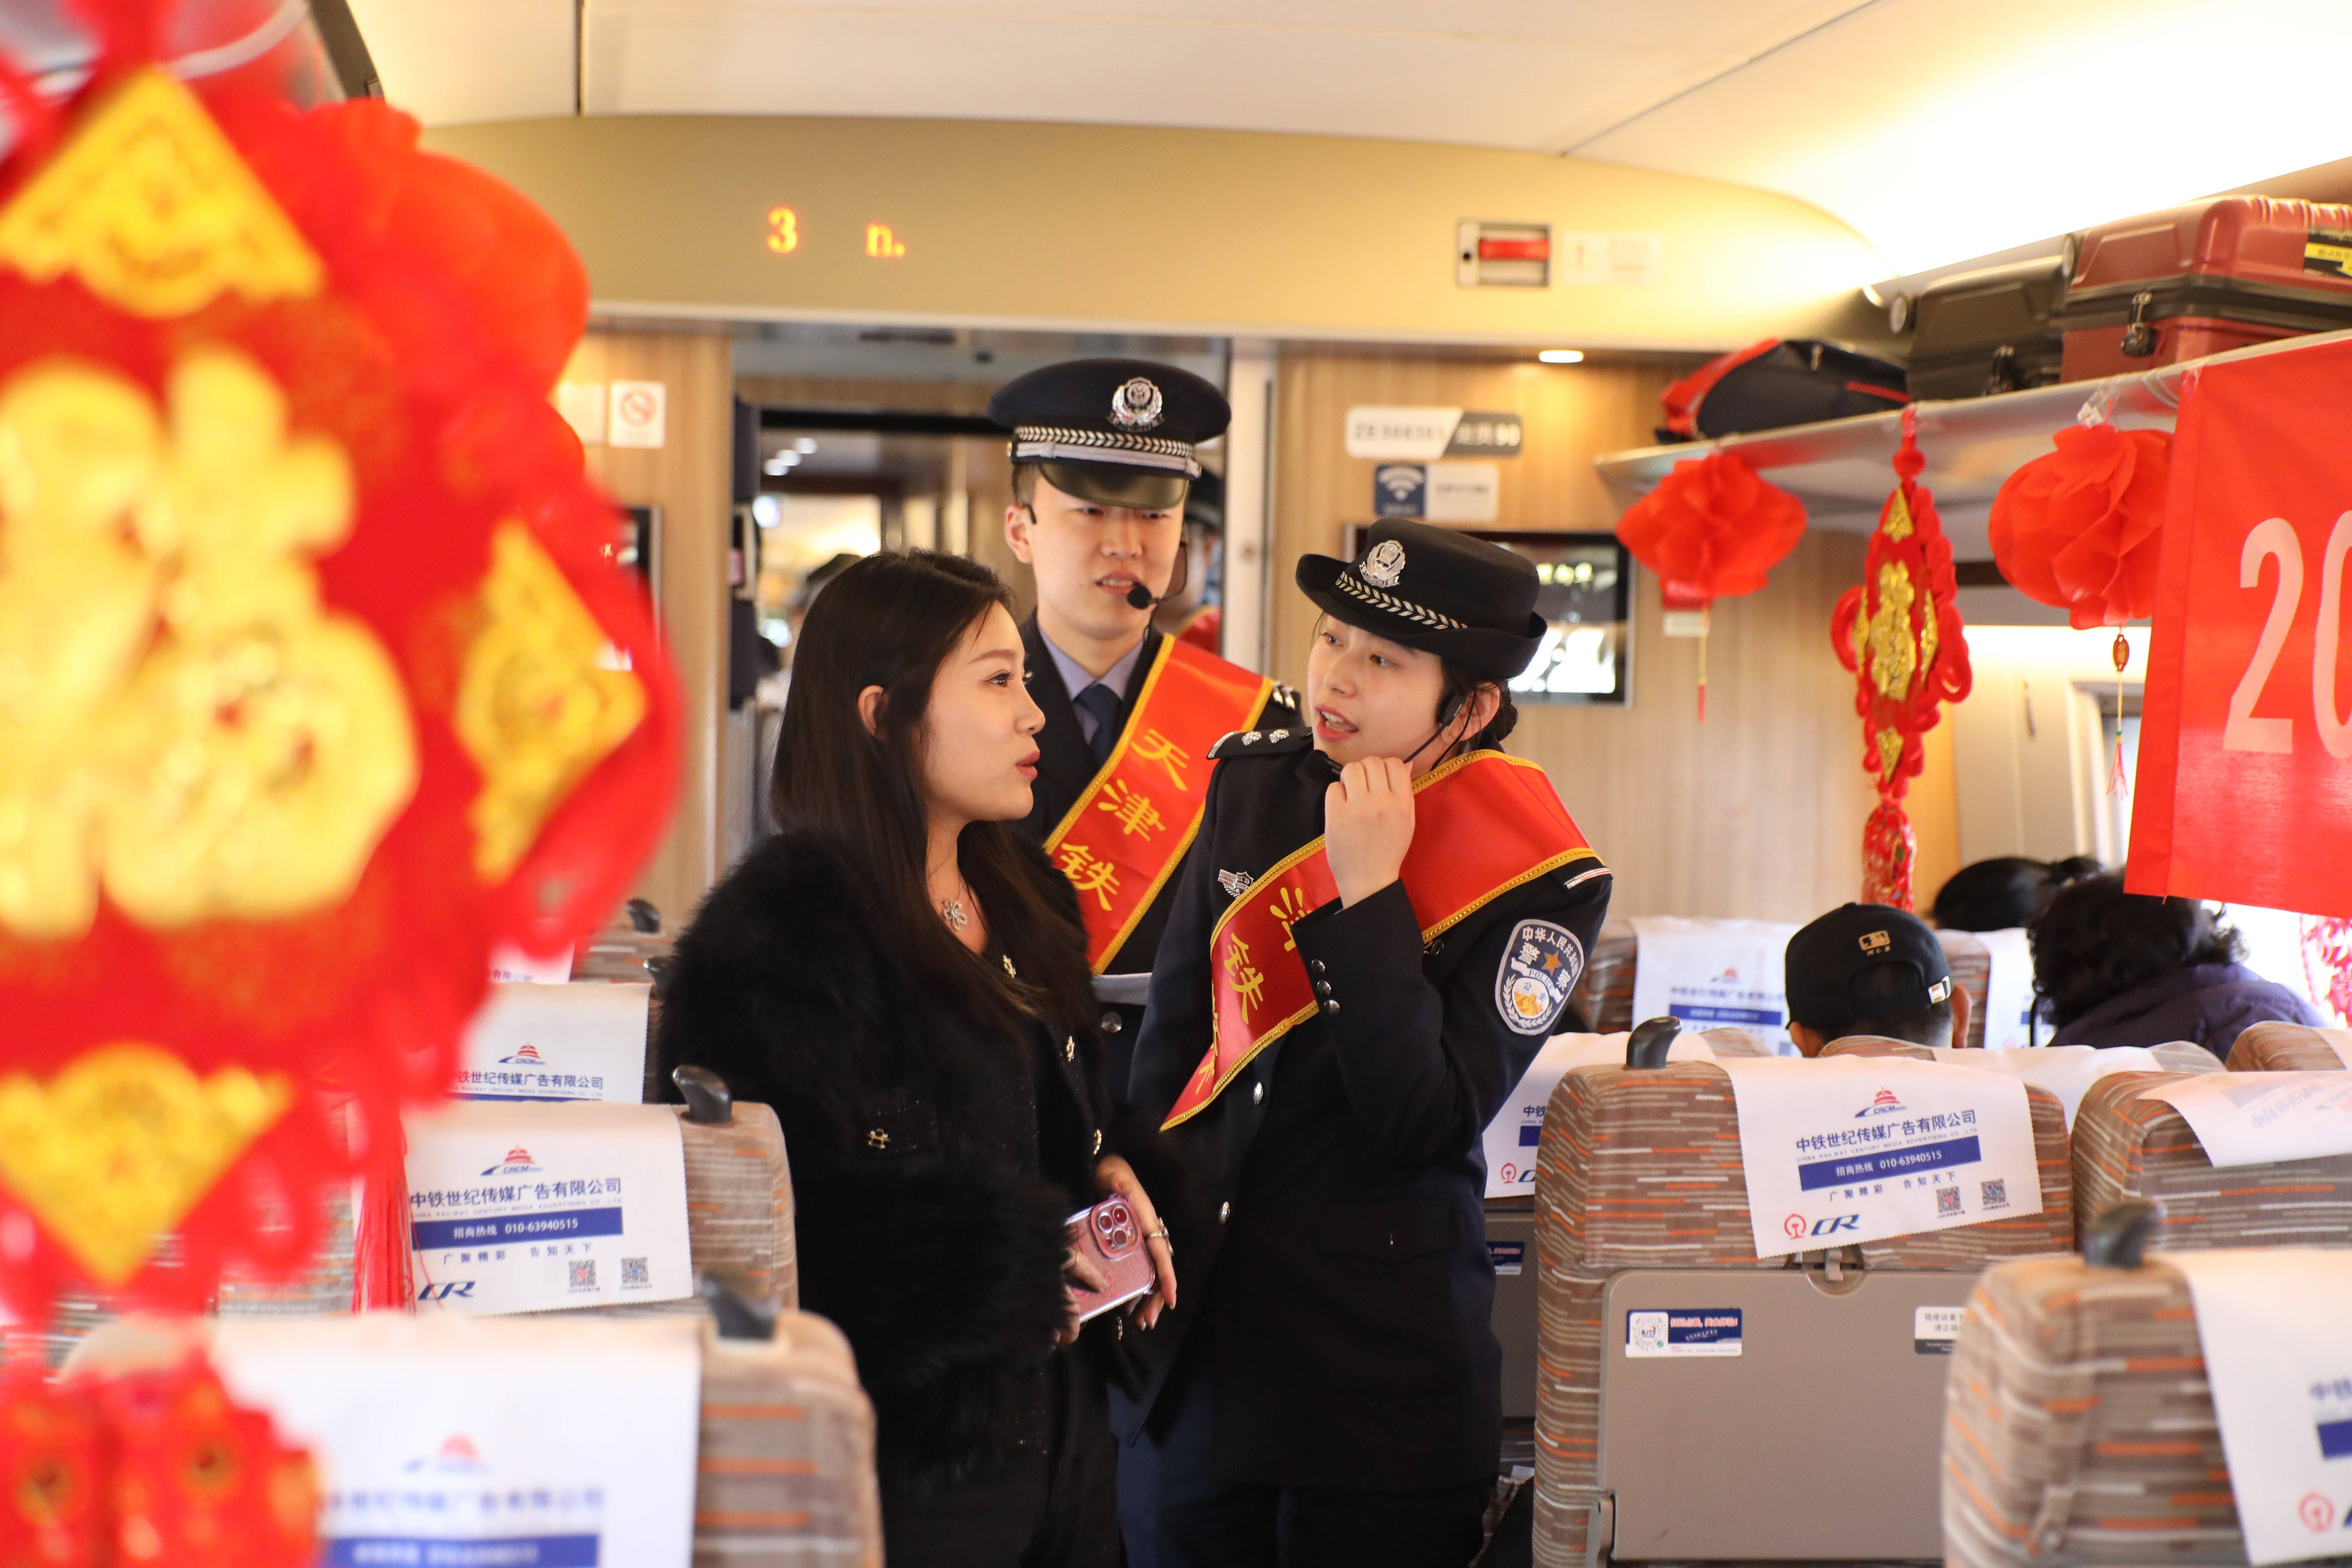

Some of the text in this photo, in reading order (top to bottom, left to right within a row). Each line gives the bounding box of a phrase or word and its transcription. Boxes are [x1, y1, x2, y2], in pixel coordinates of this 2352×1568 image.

[766, 206, 798, 254] 3
[1059, 728, 1191, 912] 天津铁
[1522, 925, 1579, 978] 中华人民共和国
[1529, 969, 1554, 991] POLICE
[458, 1070, 603, 1090] 铁世纪传媒广告有限公司
[1873, 1105, 1896, 1114] CRCM
[1796, 1109, 1977, 1153] 中铁世纪传媒广告有限公司
[1819, 1150, 1847, 1159] RAILWAY
[1851, 1144, 1880, 1154] CENTURY
[1884, 1140, 1902, 1148] MEDIA
[1906, 1134, 1948, 1144] ADVERTISING
[503, 1165, 530, 1174] CRCM
[1836, 1150, 1943, 1177] 招商热线 010-63940515
[410, 1177, 621, 1209] 中铁世纪传媒广告有限公司
[1829, 1171, 1956, 1202] 广聚精彩 告知天下
[453, 1217, 579, 1239] 招商热线 010-63940515
[1811, 1214, 1860, 1237] CR
[443, 1243, 593, 1265] 广聚精彩 告知天下
[418, 1280, 476, 1301] CR
[1935, 1324, 1958, 1332] 请正确
